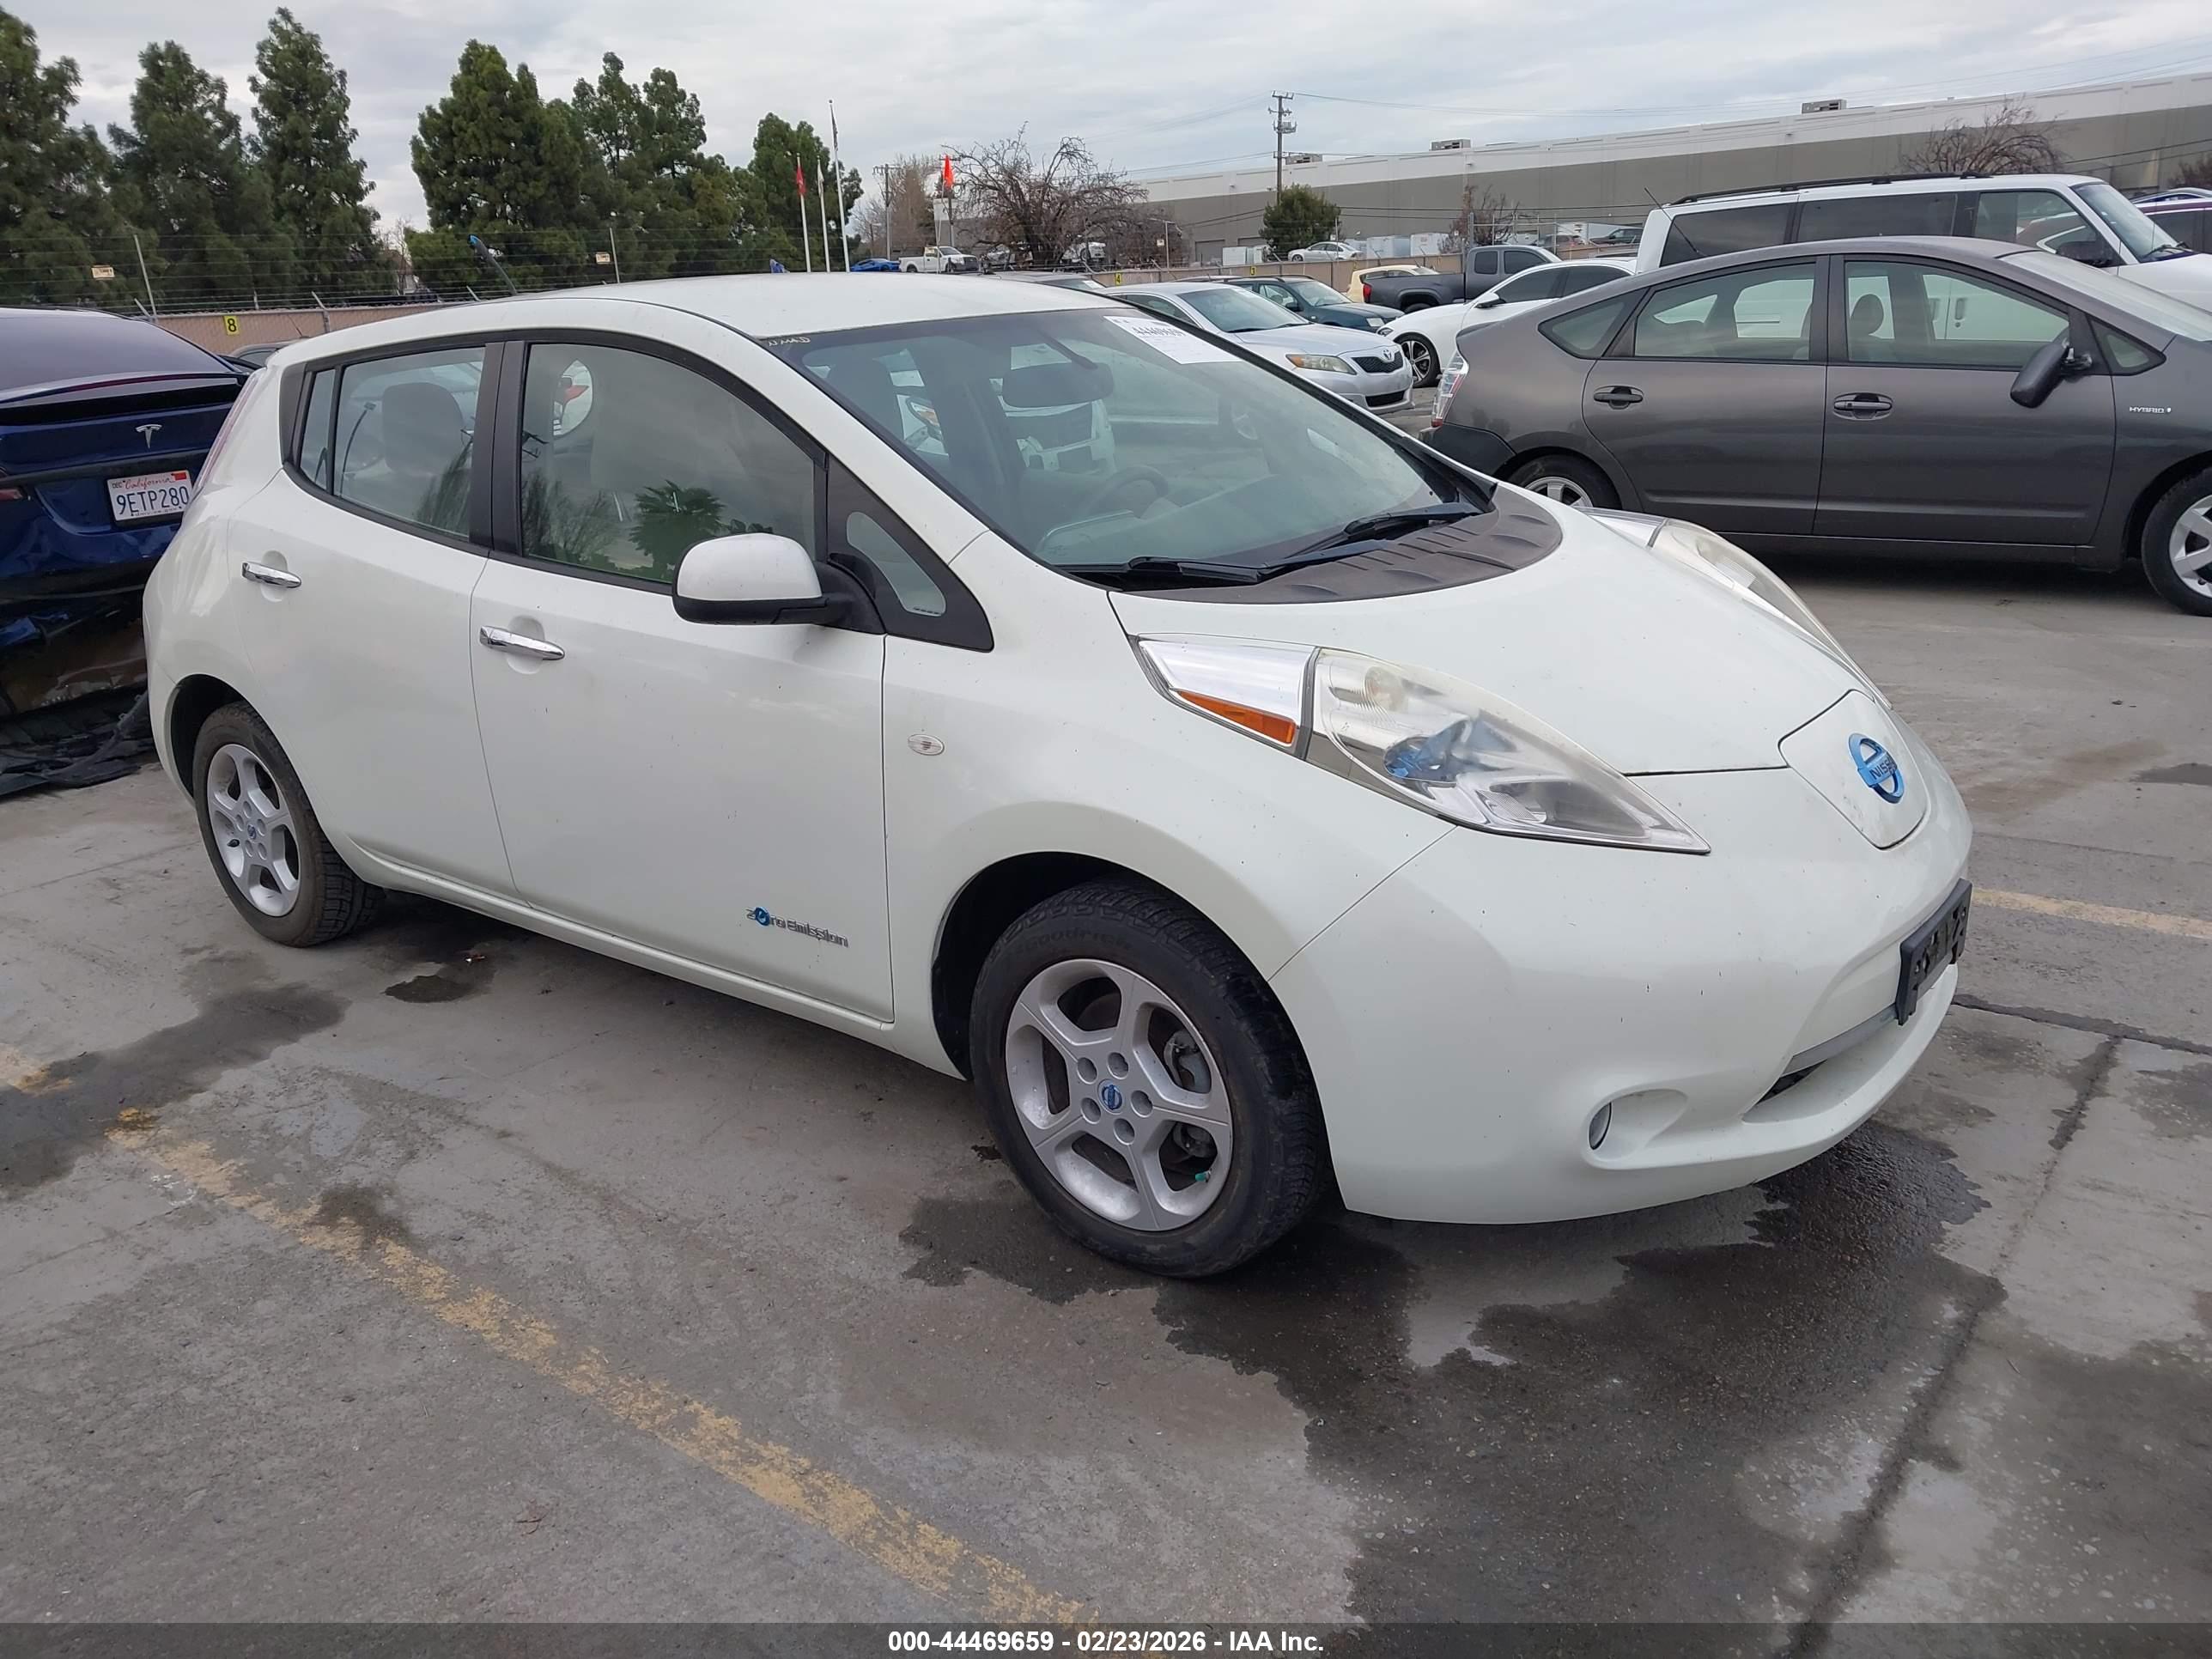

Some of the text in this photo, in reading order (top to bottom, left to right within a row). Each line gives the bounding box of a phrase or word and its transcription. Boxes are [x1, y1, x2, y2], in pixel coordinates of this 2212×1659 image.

[227, 318, 237, 332] 8
[125, 477, 174, 489] California
[116, 486, 189, 515] 9ETP280
[787, 919, 849, 948] Emission
